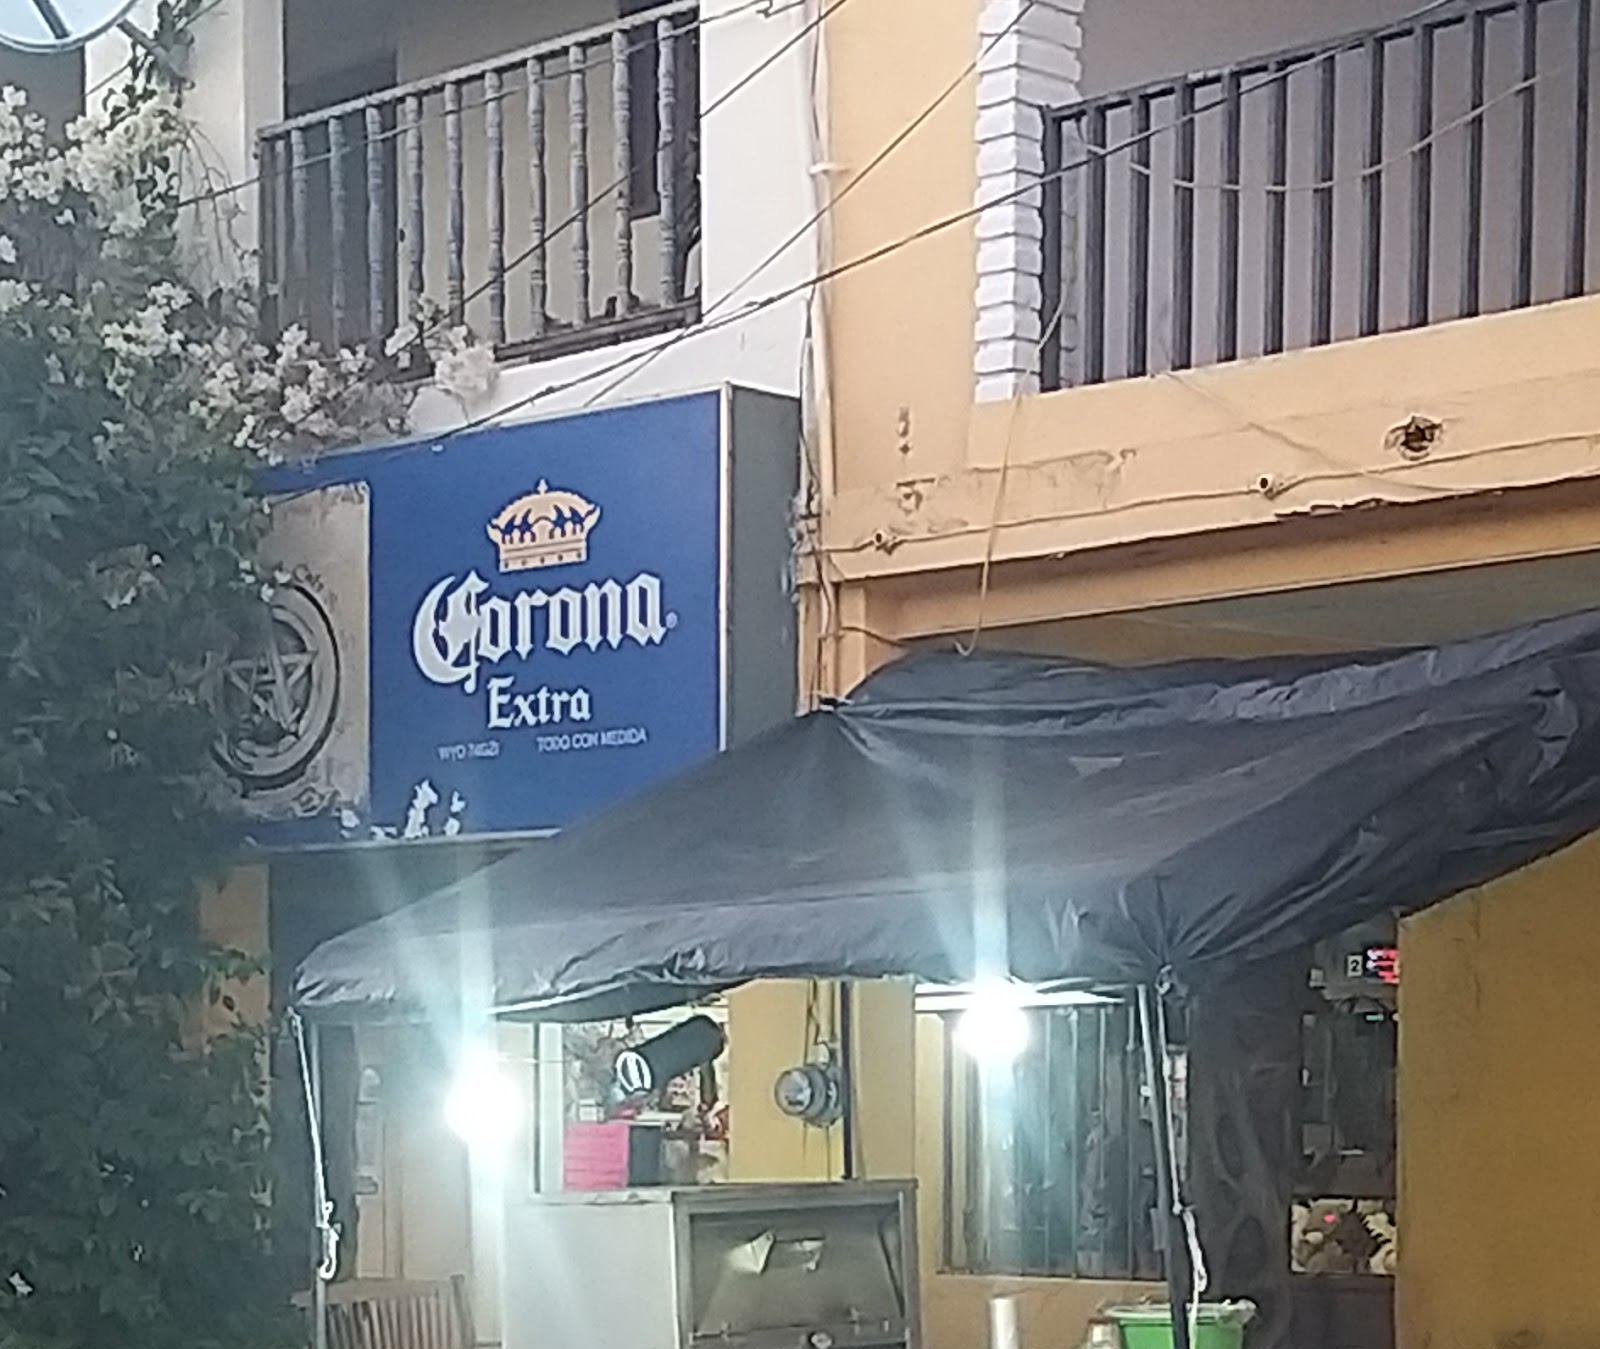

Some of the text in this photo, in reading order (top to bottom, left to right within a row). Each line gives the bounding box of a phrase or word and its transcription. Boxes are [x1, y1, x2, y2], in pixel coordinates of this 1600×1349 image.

[413, 569, 668, 694] Corona
[486, 675, 592, 729] Extra
[536, 735, 571, 752] TODO
